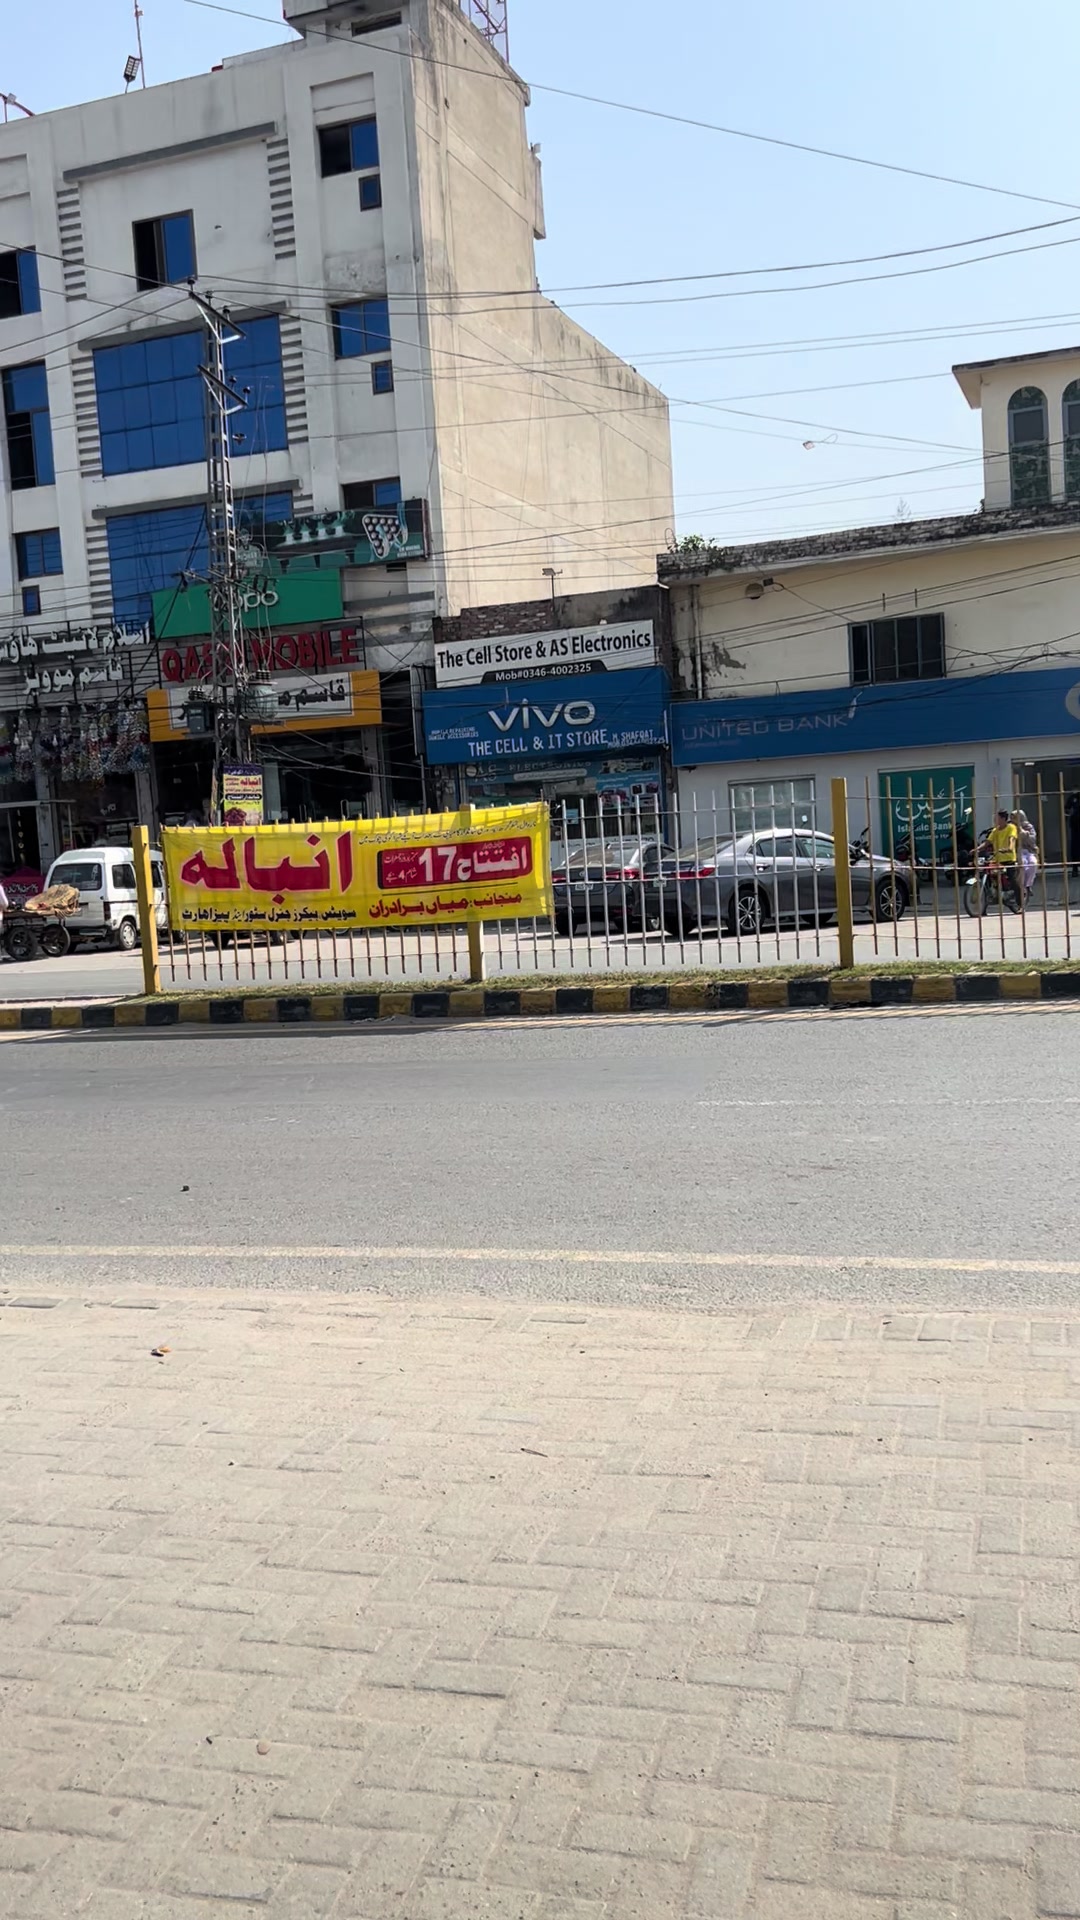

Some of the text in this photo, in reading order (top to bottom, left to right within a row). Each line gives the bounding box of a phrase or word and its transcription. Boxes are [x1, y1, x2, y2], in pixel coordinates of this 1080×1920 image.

[162, 627, 359, 683] QAS MOBILE
[437, 629, 651, 669] The Cell Store & AS Electronics
[495, 662, 592, 682] Mob#0346-4002325
[487, 698, 596, 732] vivo
[682, 713, 848, 741] UNITED BANK
[468, 740, 493, 757] THE
[495, 737, 528, 754] CELL
[533, 735, 545, 750] &
[548, 733, 562, 749] IT
[567, 728, 608, 748] STORE
[898, 823, 929, 833] Islic
[418, 845, 528, 882] افتتاح 17
[267, 907, 291, 922] جنرل
[322, 906, 356, 921] سویٹس
[369, 899, 425, 918] برادران
[426, 894, 468, 915] میاں
